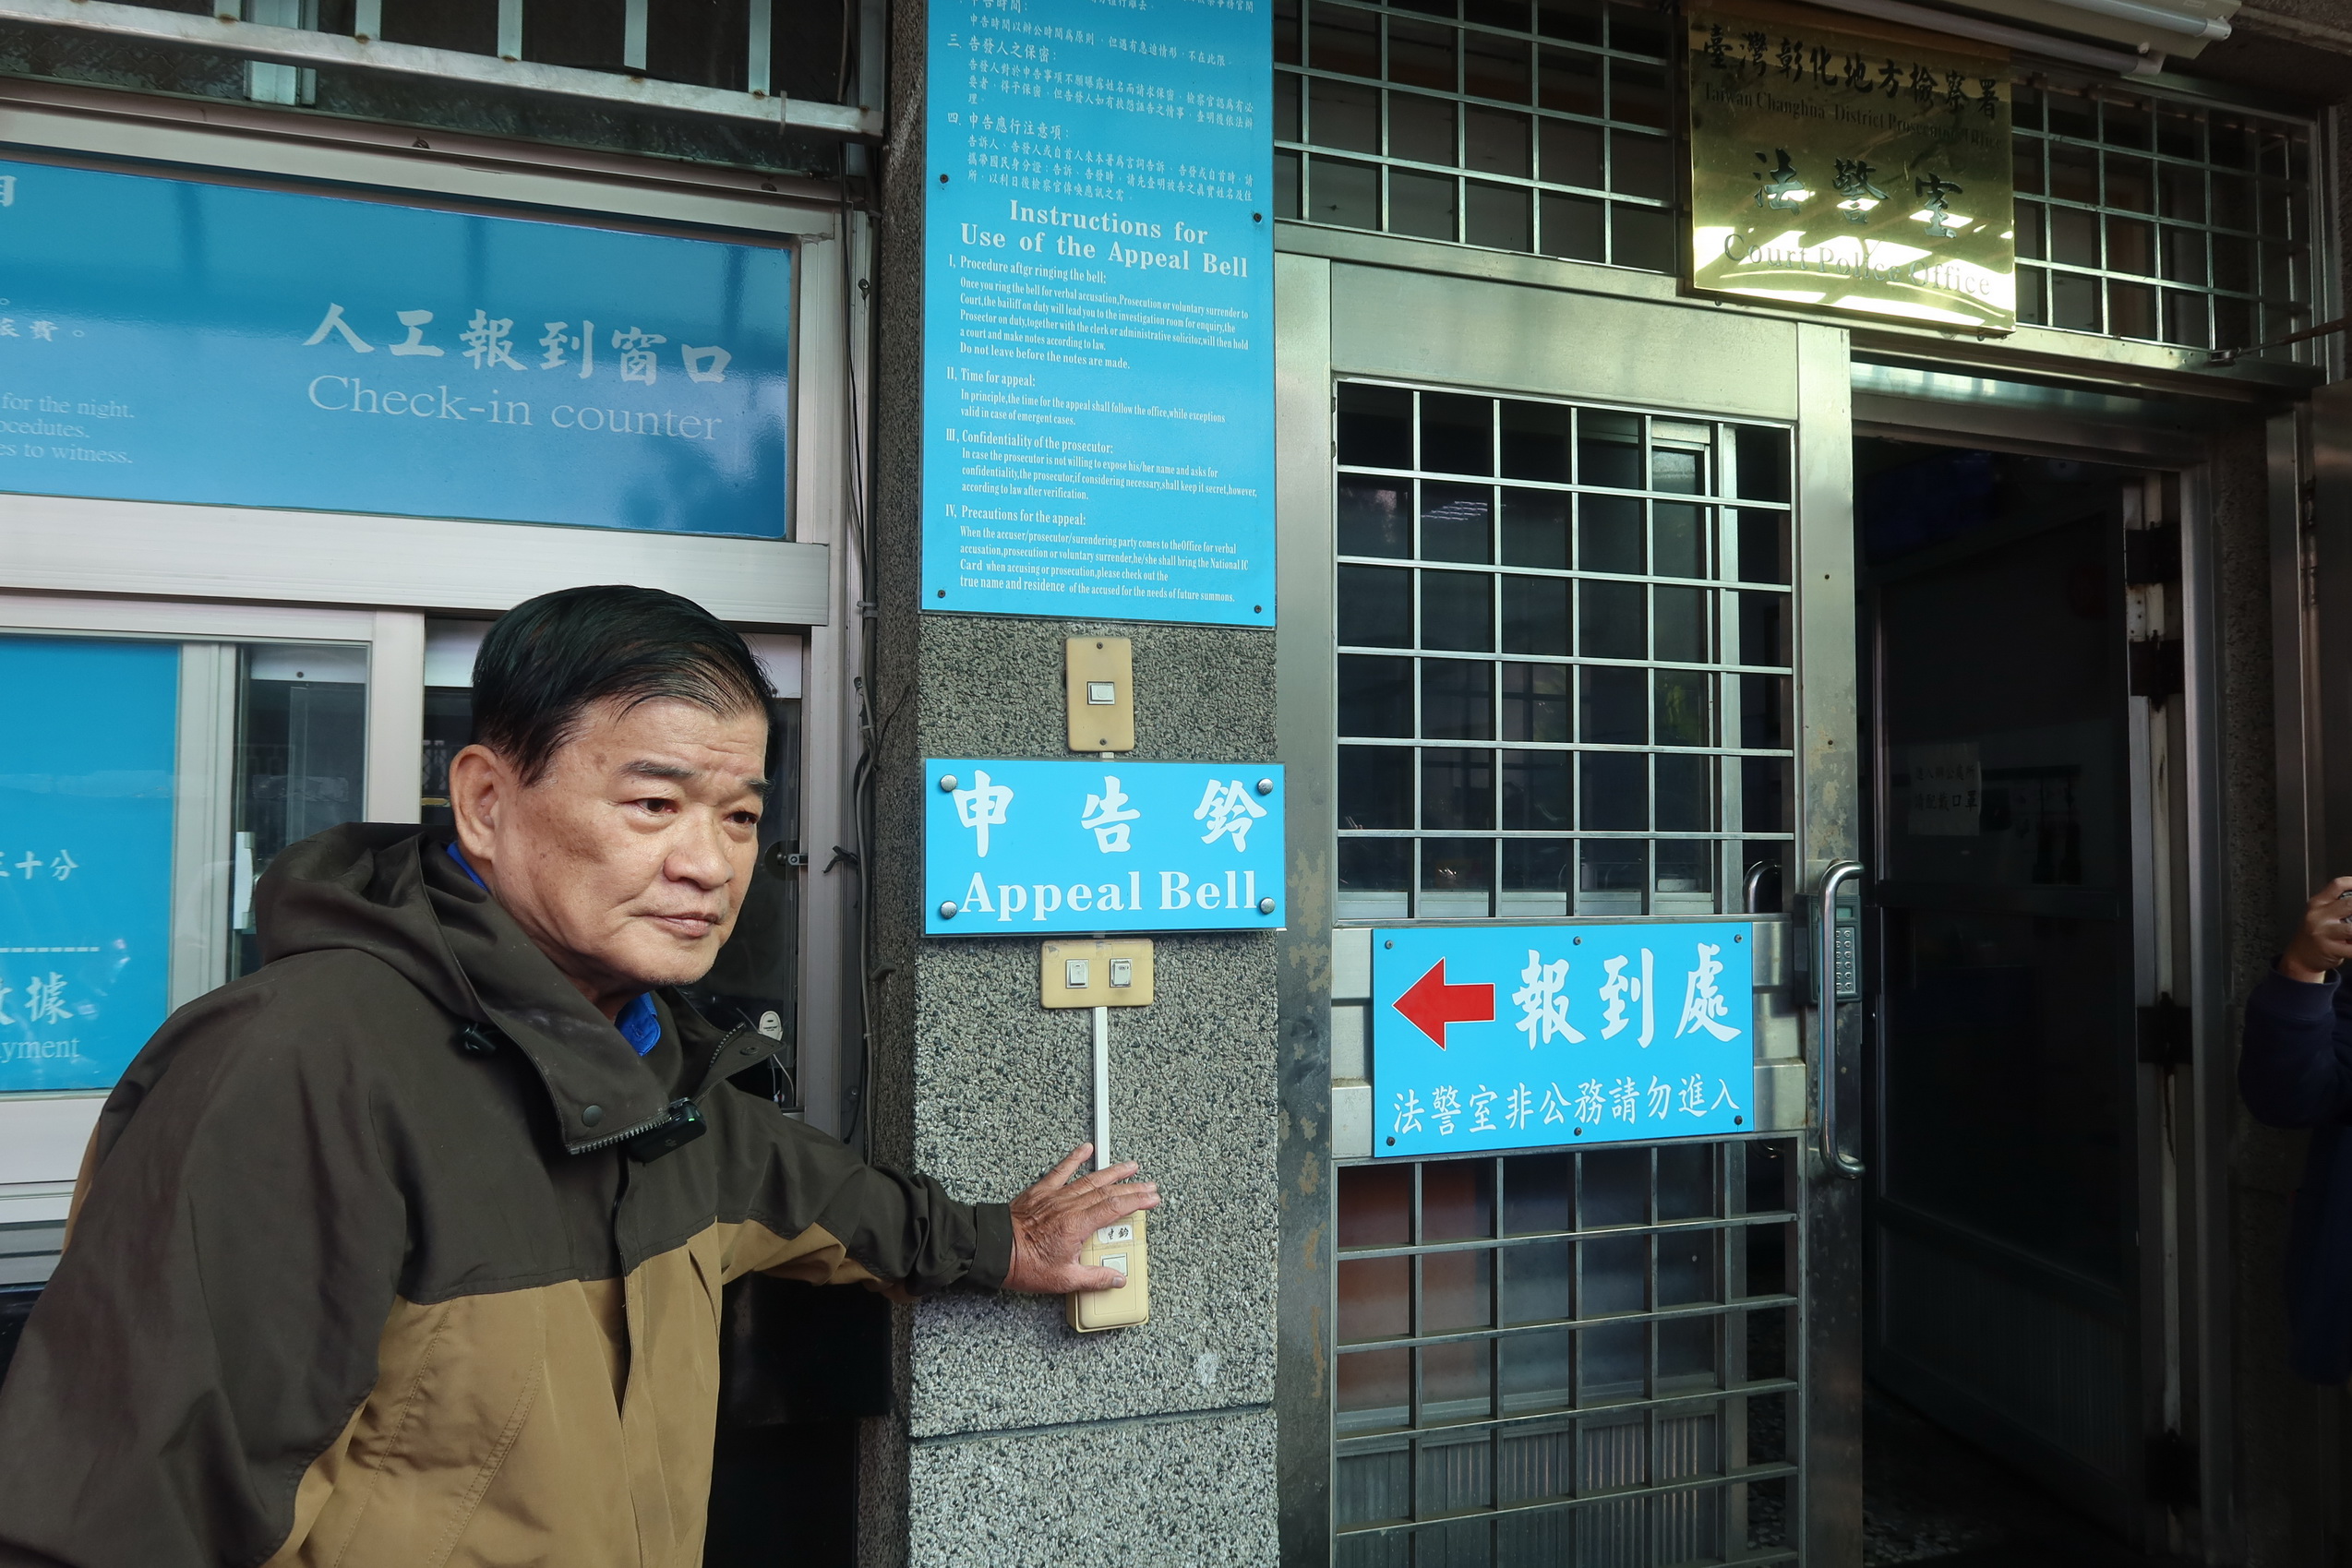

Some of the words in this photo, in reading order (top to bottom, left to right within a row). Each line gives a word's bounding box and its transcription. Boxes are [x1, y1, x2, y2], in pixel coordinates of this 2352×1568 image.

[1703, 24, 2000, 120] 臺灣彰化地方檢察署
[1757, 90, 1825, 119] Changhua
[1834, 103, 1884, 129] District
[1753, 148, 1963, 240] 法警室
[1010, 199, 1161, 238] Instructions
[1173, 221, 1208, 245] for
[960, 222, 1005, 248] Use
[1019, 231, 1046, 253] of
[1056, 234, 1096, 259] the
[1108, 241, 1189, 270] Appeal
[1203, 252, 1247, 278] Bell
[1724, 233, 1807, 270] Court
[1818, 246, 1902, 282] Police
[1909, 259, 1991, 296] Office
[960, 255, 1008, 273] Procedure
[1034, 264, 1068, 282] ringing
[1070, 268, 1084, 281] the
[1086, 269, 1106, 284] bell:
[960, 276, 979, 289] Once
[979, 281, 993, 291] you
[994, 280, 1011, 293] ring
[1012, 281, 1025, 294] the
[1026, 283, 1039, 296] bell
[1041, 285, 1052, 297] for
[1053, 287, 1076, 300] verbal
[1162, 302, 1170, 311] or
[1171, 301, 1205, 316] voluntary
[1206, 306, 1241, 318] surrender
[1241, 309, 1248, 320] to
[302, 302, 734, 387] 人工報到窗口
[960, 341, 972, 354] Do
[974, 345, 989, 355] not
[990, 344, 1014, 358] leave
[1015, 347, 1045, 361] before
[1046, 350, 1061, 363] the
[1062, 353, 1086, 365] notes
[1088, 357, 1103, 366] are
[1105, 357, 1130, 369] made.
[966, 329, 986, 339] court
[987, 329, 1002, 341] and
[1003, 330, 1023, 342] make
[1025, 334, 1045, 344] notes
[1046, 336, 1082, 350] according
[1083, 339, 1091, 349] to
[1092, 338, 1106, 351] law.
[960, 367, 983, 382] Time
[986, 369, 1000, 384] for
[1001, 374, 1035, 388] appeal:
[2, 391, 33, 412] for
[39, 395, 71, 413] the
[77, 399, 135, 420] night.
[307, 374, 533, 427] Check-in
[551, 398, 723, 442] counter
[960, 405, 979, 418] valid
[981, 407, 989, 418] in
[990, 411, 1007, 420] case
[1008, 409, 1016, 421] of
[1016, 413, 1052, 425] emergent
[1053, 415, 1075, 425] cases.
[24, 443, 44, 459] to
[52, 443, 133, 464] witness.
[962, 429, 1032, 449] Confidentiality
[1034, 435, 1044, 449] of
[1044, 436, 1060, 449] the
[1062, 440, 1112, 454] prosecutor:
[962, 447, 970, 459] In
[971, 450, 989, 461] case
[990, 449, 1002, 461] the
[1003, 453, 1045, 464] prosecutor
[1046, 453, 1052, 465] is
[1053, 456, 1066, 466] not
[1067, 456, 1093, 470] willing
[1094, 459, 1101, 469] to
[1102, 461, 1127, 472] expose
[1156, 465, 1175, 474] name
[1175, 464, 1189, 476] and
[1190, 465, 1206, 477] asks
[1207, 466, 1218, 478] for
[961, 482, 1000, 495] according
[1000, 484, 1008, 495] to
[1009, 483, 1022, 496] law
[1023, 485, 1042, 497] after
[1043, 486, 1088, 500] verification.
[961, 504, 1018, 521] Precautions
[1020, 509, 1034, 522] for
[1035, 509, 1050, 523] the
[1051, 512, 1086, 526] appeal:
[959, 525, 981, 538] When
[982, 527, 995, 539] the
[1118, 537, 1137, 550] party
[1138, 540, 1160, 549] comes
[1160, 539, 1169, 550] to
[1203, 541, 1214, 553] for
[1214, 543, 1236, 555] verbal
[959, 558, 982, 571] Card
[986, 560, 1005, 572] when
[1006, 563, 1039, 575] accusing
[1040, 566, 1050, 575] or
[1121, 568, 1142, 581] check
[1143, 571, 1155, 581] out
[1157, 570, 1168, 581] the
[959, 574, 978, 588] true
[980, 579, 1003, 589] name
[1005, 577, 1022, 591] and
[1023, 578, 1065, 592] residence
[1068, 581, 1077, 593] of
[1077, 582, 1090, 594] the
[1090, 584, 1120, 596] accused
[1121, 584, 1133, 596] for
[1133, 585, 1146, 597] the
[1146, 587, 1168, 599] needs
[1168, 587, 1176, 599] of
[1177, 588, 1199, 601] future
[1200, 592, 1235, 603] summons.
[952, 769, 1268, 858] 申告鈴
[958, 870, 1144, 922] Appeal
[1158, 869, 1258, 911] Bell
[1511, 942, 1743, 1051] 報到處
[0, 1036, 80, 1063] yment
[1393, 1072, 1741, 1137] 法警室非公務請勿進入
